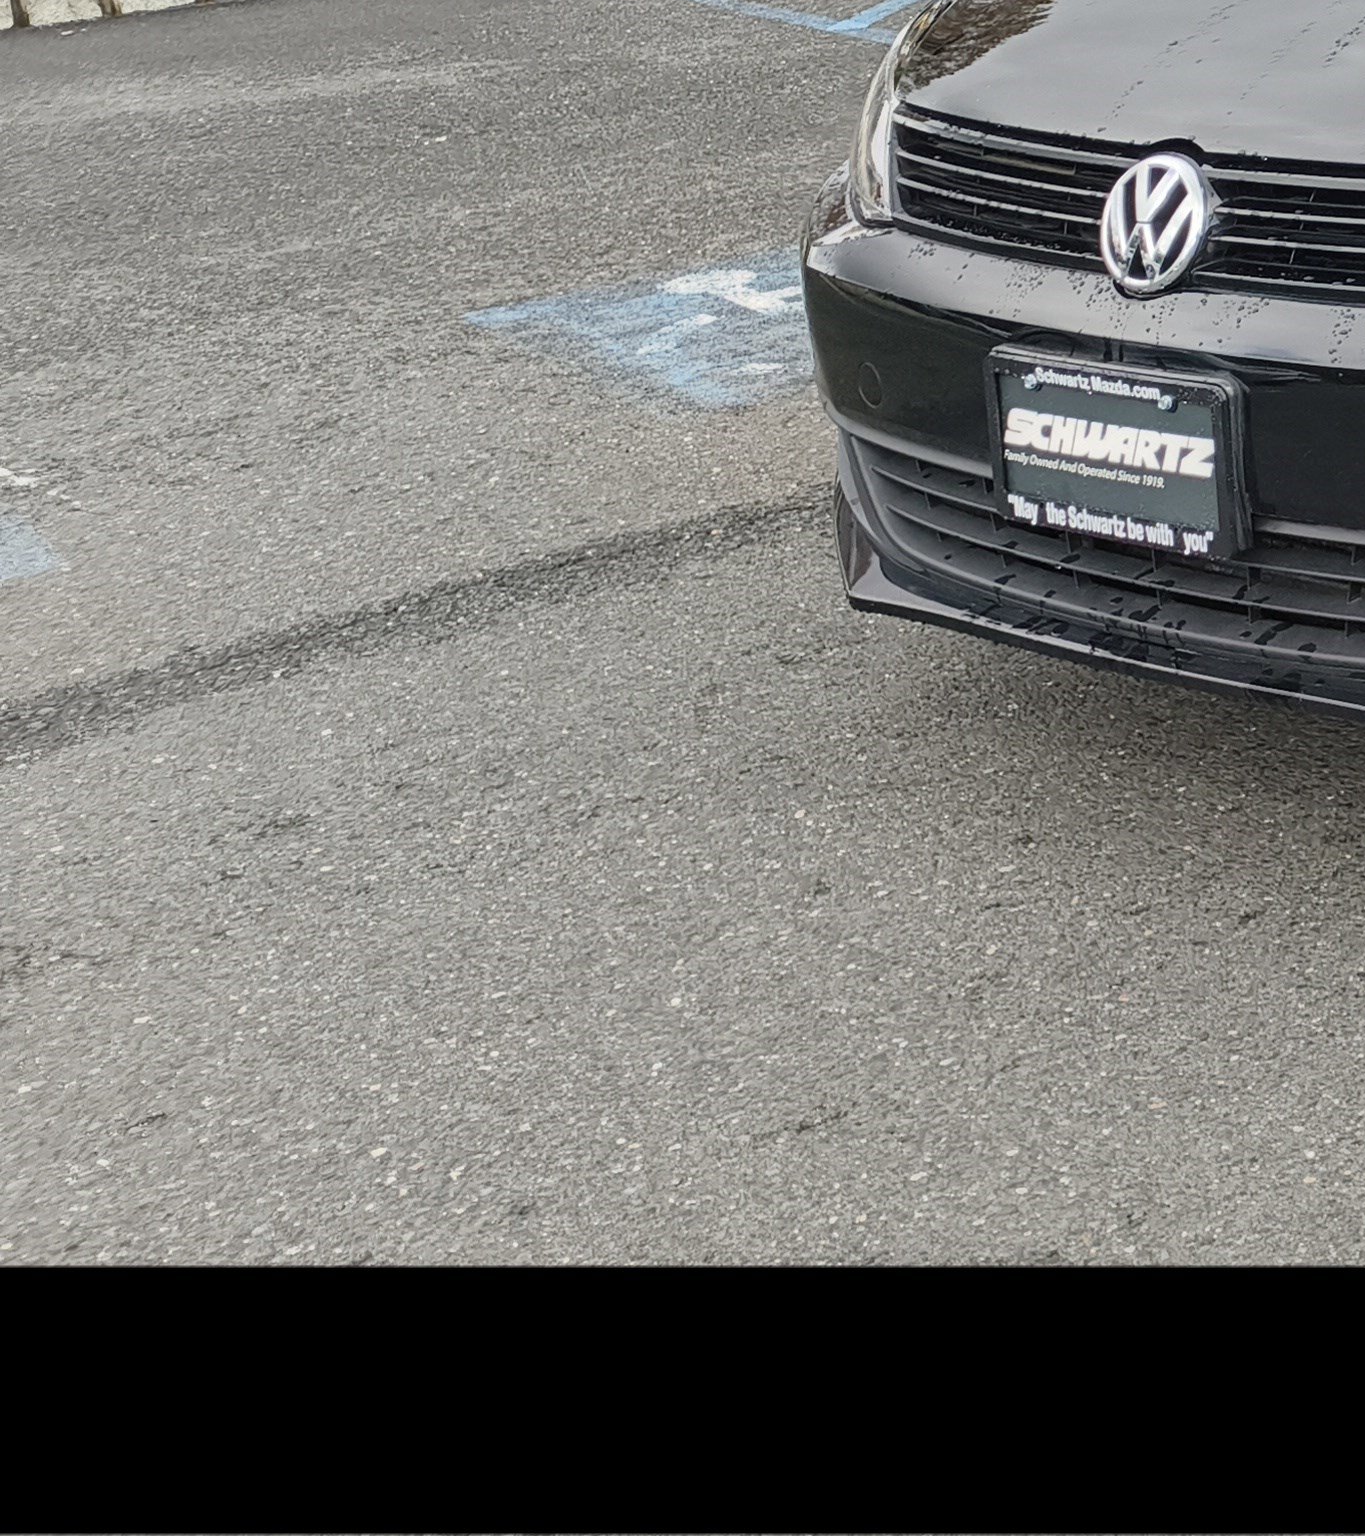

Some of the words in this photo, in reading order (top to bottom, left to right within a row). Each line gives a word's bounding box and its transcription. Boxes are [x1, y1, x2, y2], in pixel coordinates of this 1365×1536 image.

[1003, 407, 1216, 479] SCHWARTZ
[1004, 449, 1029, 466] Family
[1030, 454, 1058, 470] Owned
[1060, 460, 1077, 473] And
[1078, 463, 1117, 481] Operated
[1117, 469, 1140, 485] Since
[1046, 502, 1067, 526] the
[1068, 505, 1126, 540] Schwartz
[1127, 517, 1145, 542] be
[1146, 522, 1174, 547] with
